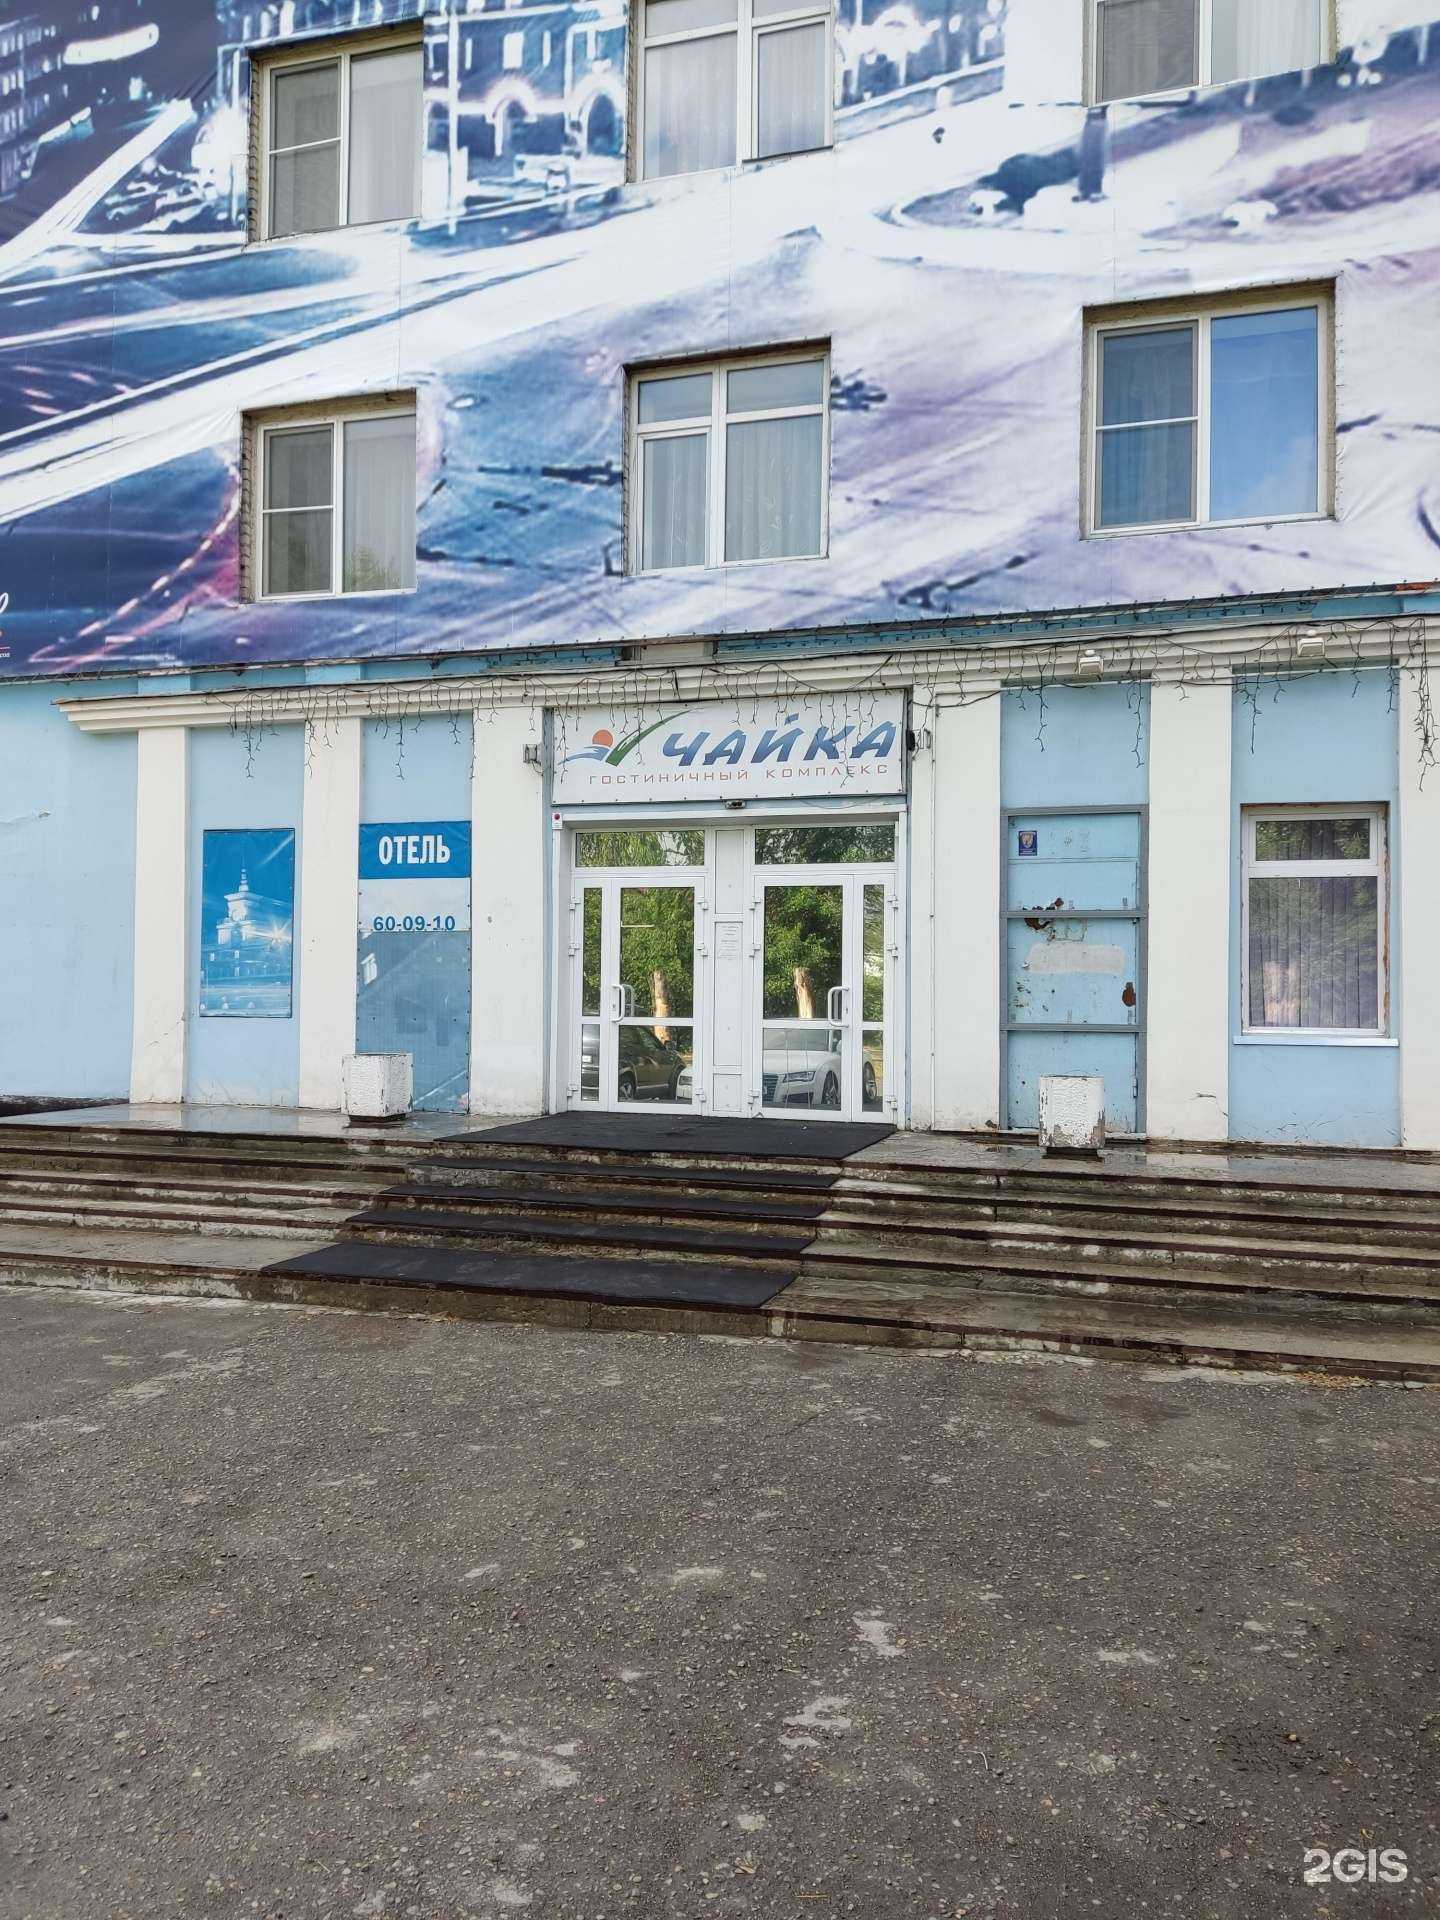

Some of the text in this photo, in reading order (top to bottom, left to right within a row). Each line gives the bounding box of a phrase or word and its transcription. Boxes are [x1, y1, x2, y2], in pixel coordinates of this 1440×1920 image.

[662, 712, 897, 767] ЧАЙКА
[589, 764, 888, 785] ГОСТИНИЧНЫЙ КОМПЛЕКС
[378, 834, 451, 865] ОТЕЛЬ
[372, 915, 456, 931] 60-09-10
